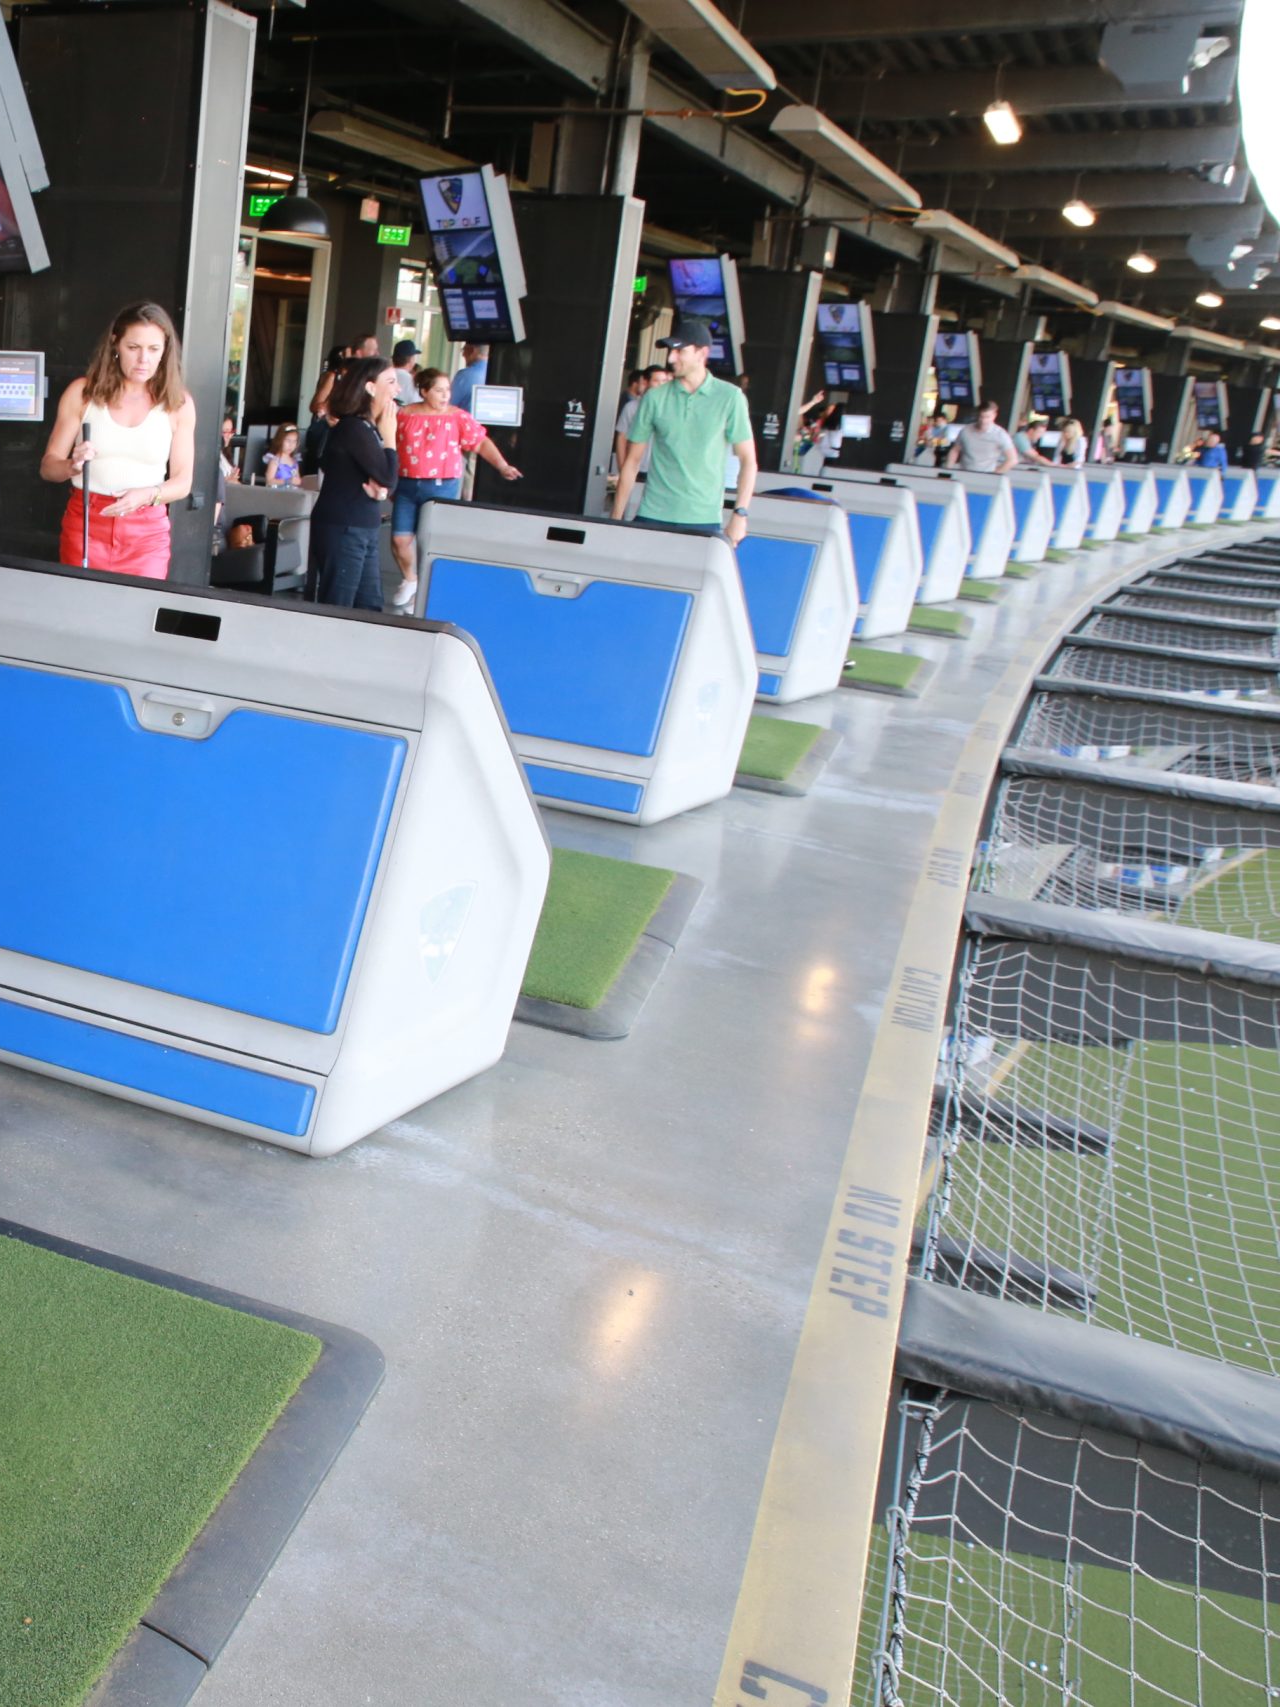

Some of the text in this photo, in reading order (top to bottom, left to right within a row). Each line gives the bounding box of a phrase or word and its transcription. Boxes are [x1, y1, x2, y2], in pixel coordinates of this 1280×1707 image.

[891, 966, 942, 1032] CAUTION
[828, 1184, 902, 1319] NO STEP
